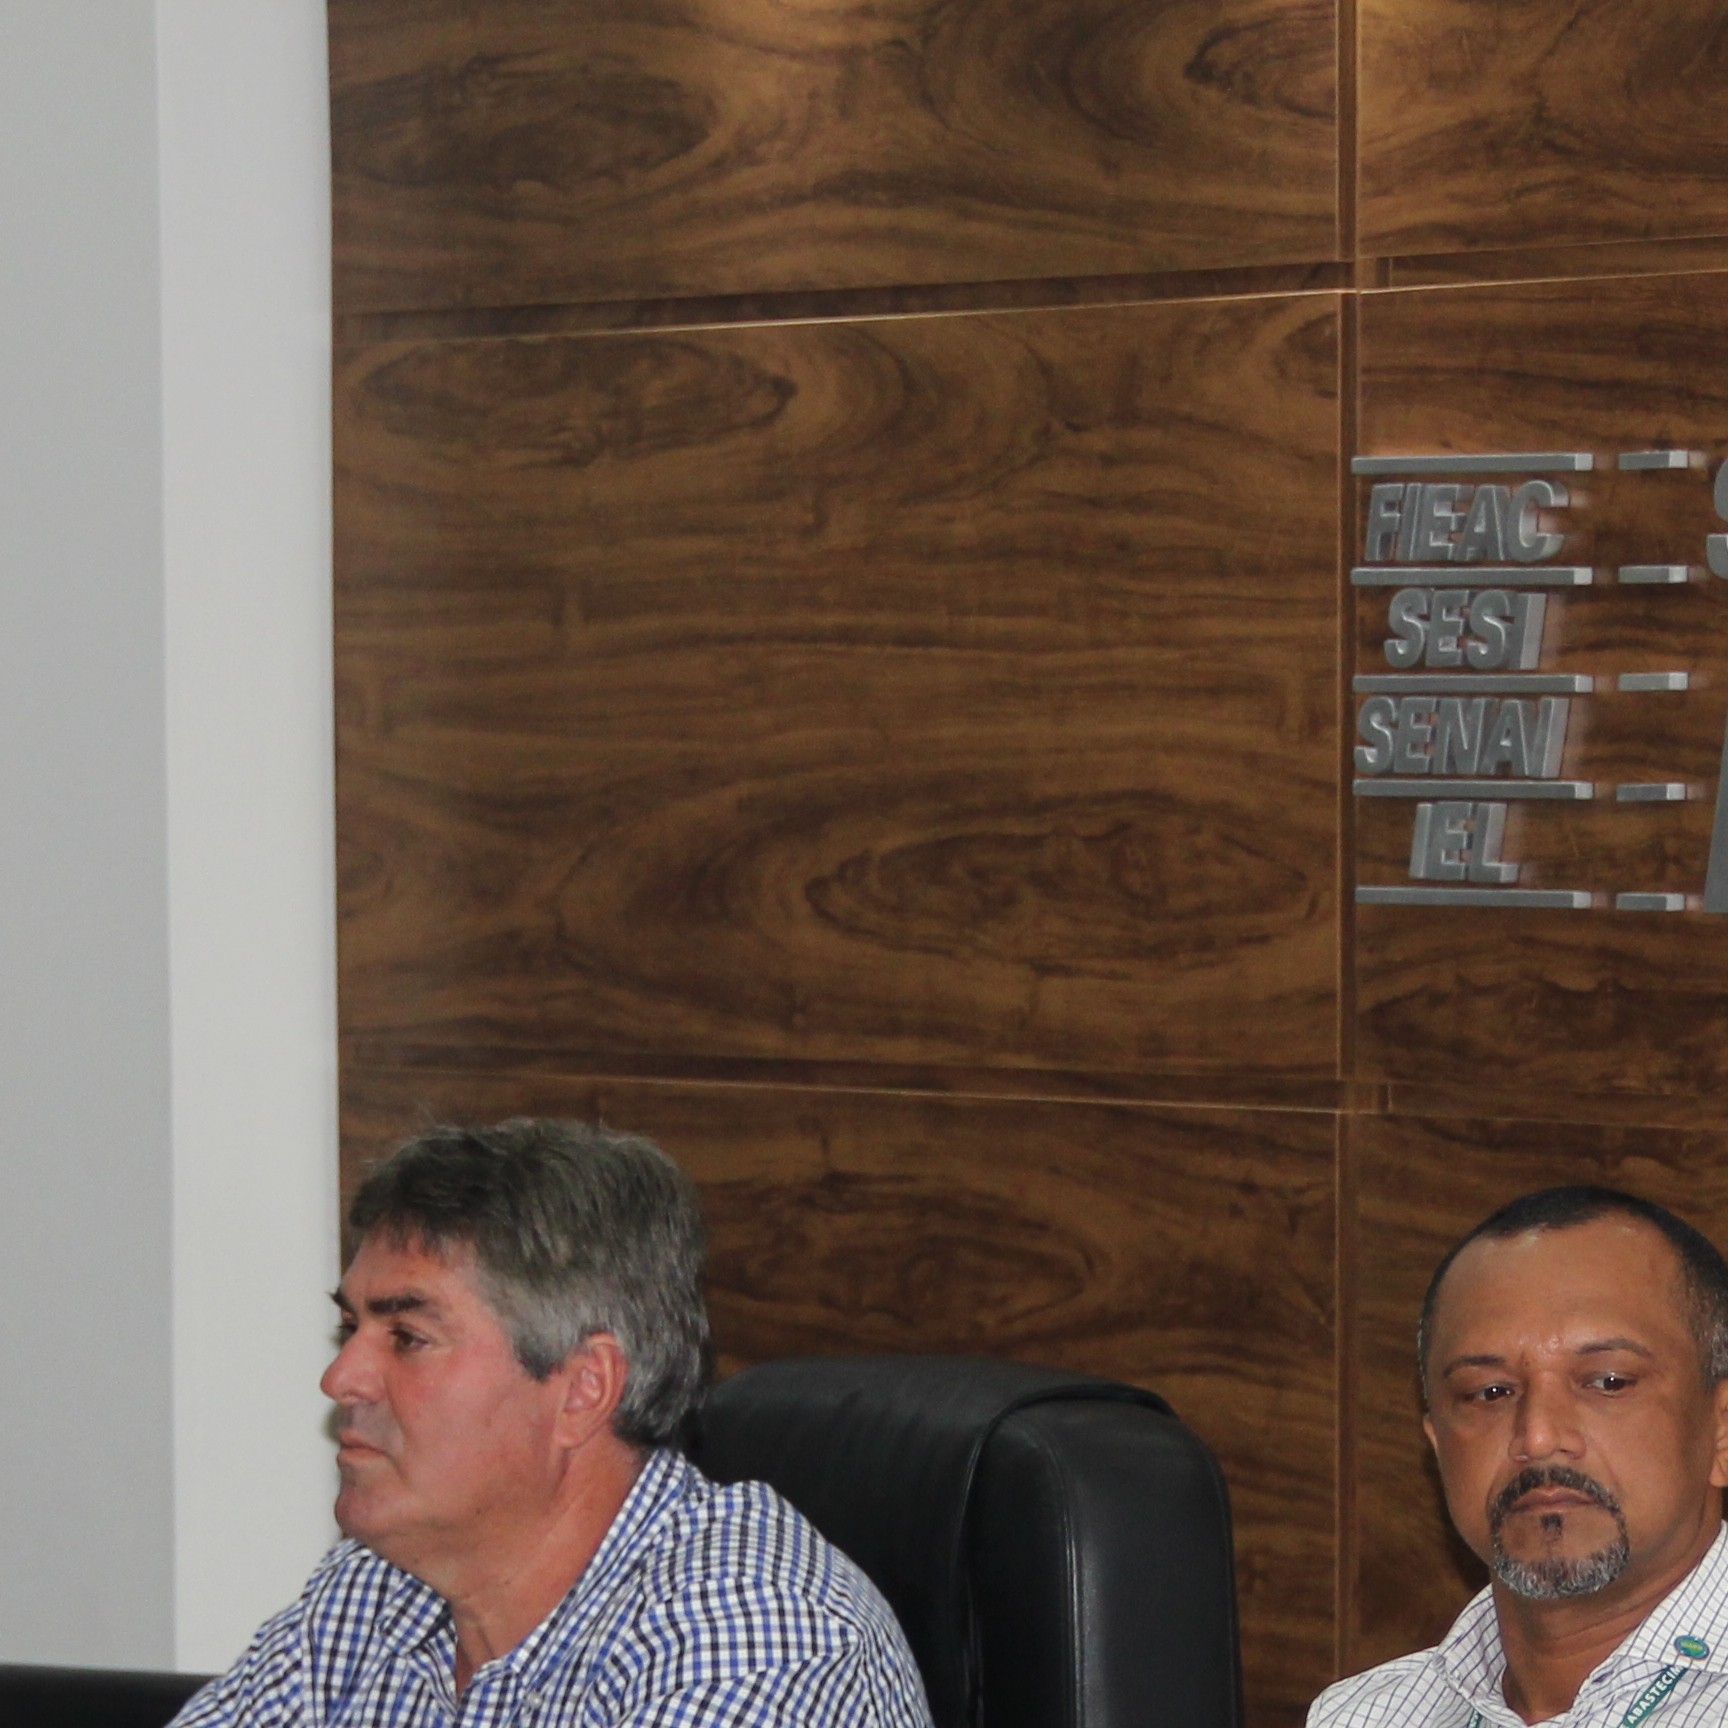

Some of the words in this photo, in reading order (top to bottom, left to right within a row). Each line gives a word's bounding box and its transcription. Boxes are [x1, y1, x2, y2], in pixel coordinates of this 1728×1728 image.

[1365, 479, 1569, 563] FIEAC
[1384, 587, 1547, 671] SESI
[1353, 695, 1570, 779] SENAI
[1409, 801, 1519, 884] IEL
